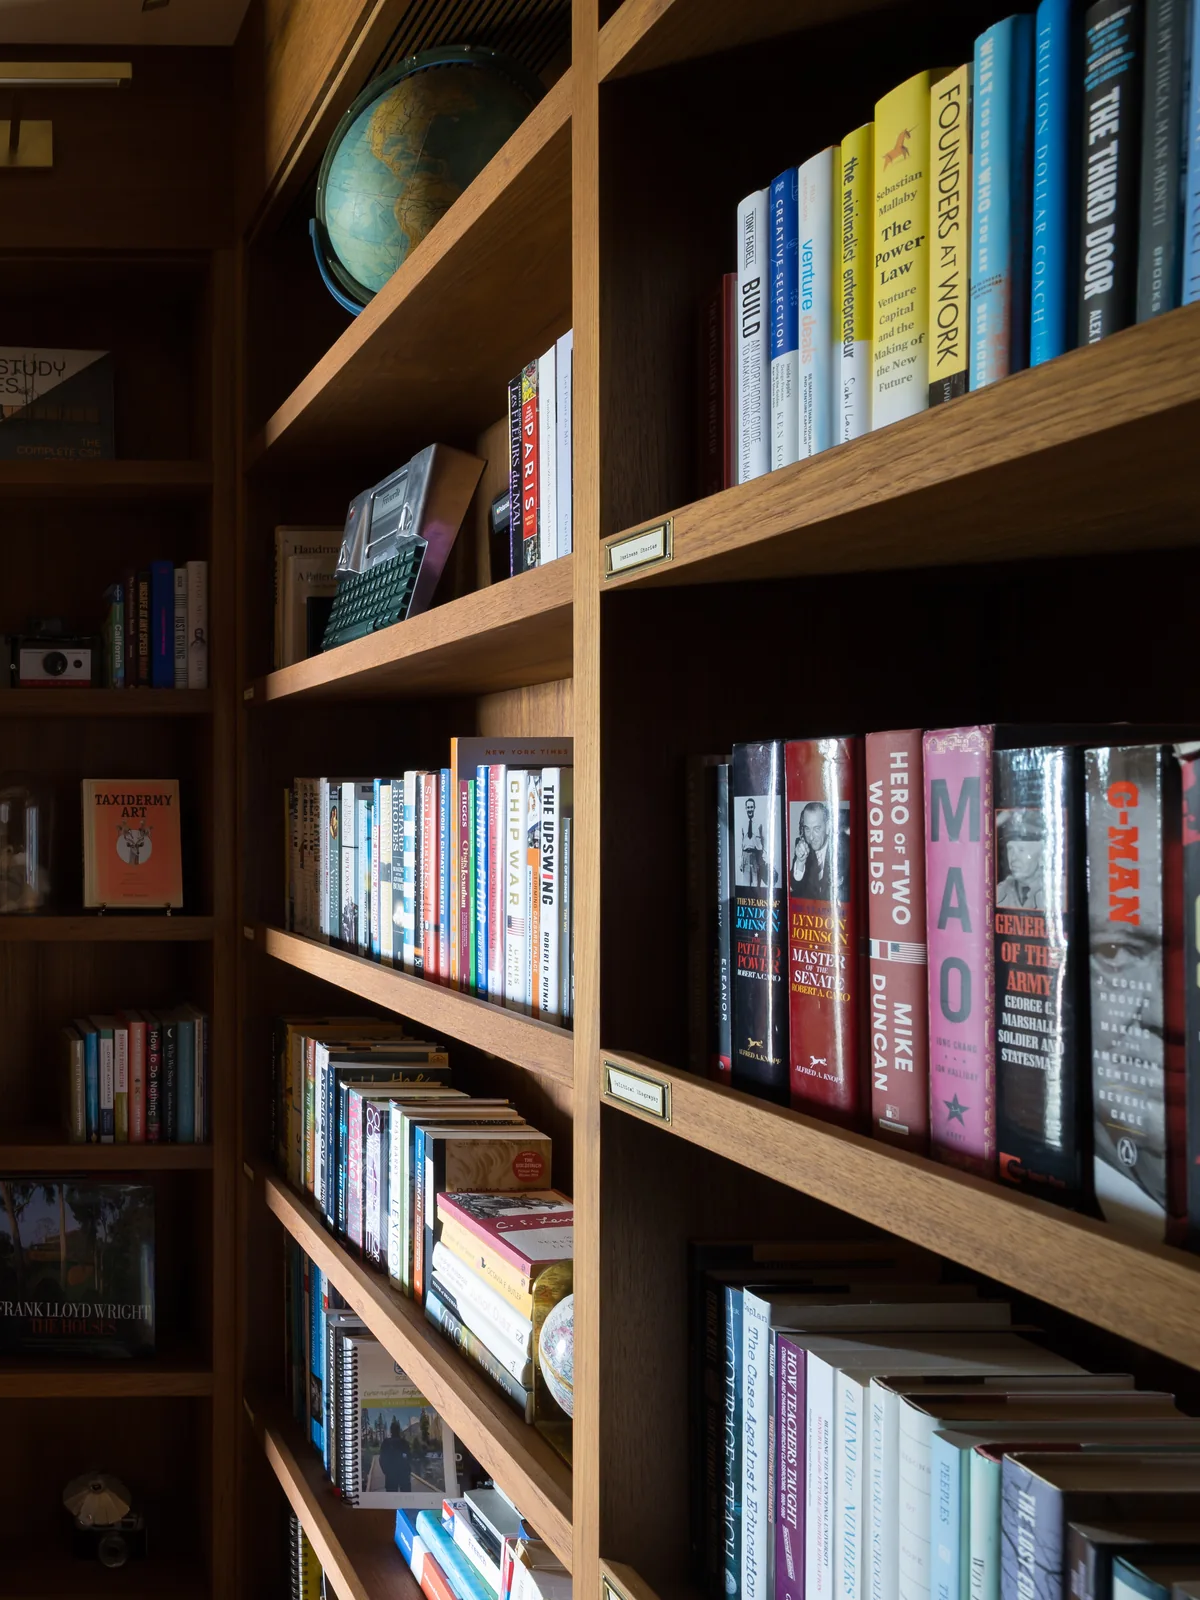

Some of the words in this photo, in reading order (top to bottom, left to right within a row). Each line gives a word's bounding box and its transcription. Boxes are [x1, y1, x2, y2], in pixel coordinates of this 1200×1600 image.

[1036, 22, 1052, 135] TRILLION
[1088, 86, 1121, 145] THE
[842, 156, 858, 184] the
[937, 81, 961, 242] FOUNDERS
[876, 169, 923, 203] Sebastian
[1034, 143, 1049, 237] DOLLAR
[1086, 142, 1119, 225] THIRD
[878, 188, 918, 218] Mallaby
[744, 210, 755, 235] TONY
[775, 198, 784, 268] CREATIVE
[842, 189, 860, 263] minimalist
[881, 217, 913, 243] The
[744, 235, 756, 269] FADELL
[875, 232, 926, 269] Power
[939, 245, 957, 274] AT
[1083, 223, 1116, 301] DOOR
[801, 239, 816, 311] venture
[880, 258, 914, 286] Law
[1032, 245, 1047, 325] COACH
[1151, 246, 1164, 313] BROOKS
[742, 276, 761, 339] BUILD
[775, 272, 784, 349] SELECTION
[841, 268, 857, 360] entrepreneur
[877, 284, 917, 310] Venture
[878, 302, 915, 326] Capital
[878, 327, 896, 343] and
[896, 319, 915, 337] the
[935, 275, 961, 368] WORK
[1088, 309, 1102, 336] ALEX
[801, 315, 817, 364] deals
[874, 340, 908, 363] Making
[909, 332, 925, 348] of
[876, 361, 891, 377] the
[892, 354, 918, 371] New
[878, 371, 913, 393] Future
[524, 422, 535, 512] PARIS
[139, 581, 148, 610] UNSAFE
[139, 610, 148, 618] AT
[139, 618, 148, 633] ANY
[175, 616, 185, 632] JUST
[114, 623, 123, 669] California
[139, 633, 148, 656] SPEED
[175, 634, 185, 660] GIVING
[94, 794, 173, 806] TAXIDERMY
[543, 785, 555, 816] THE
[888, 750, 910, 827] HERO
[121, 806, 147, 818] ART
[397, 788, 405, 853] RICHARD
[508, 780, 521, 841] CHIP
[868, 780, 885, 898] WORLDS
[893, 832, 907, 856] OF
[1107, 780, 1140, 927] G-MAN
[508, 849, 521, 907] WAR
[542, 820, 554, 906] UPSWING
[891, 859, 912, 927] TWO
[929, 775, 981, 1025] MAO
[735, 917, 781, 933] JOHNSON
[736, 905, 780, 921] LYNDON
[792, 912, 848, 931] LYNDON
[542, 931, 550, 965] ROBERT
[791, 926, 850, 946] JOHNSON
[542, 966, 549, 975] D.
[737, 956, 781, 974] POWER
[791, 947, 847, 970] MASTER
[1001, 940, 1021, 962] OF
[1023, 942, 1061, 969] THE
[541, 976, 550, 1012] PUTNAM
[720, 957, 729, 1022] ELEANOR
[791, 981, 817, 997] ROBERT
[817, 987, 826, 998] A.
[825, 988, 851, 1003] CARO
[793, 969, 846, 991] SENATE
[1006, 970, 1053, 997] ARMY
[1111, 976, 1154, 993] EDGAR
[1004, 994, 1043, 1014] GEORGE
[1100, 991, 1151, 1009] HOOVER
[149, 1031, 158, 1051] How
[871, 973, 888, 1093] DUNCAN
[893, 1001, 915, 1074] MIKE
[997, 1028, 1040, 1051] SOLDIER
[1040, 1036, 1065, 1057] AND
[1100, 1020, 1153, 1040] MAKING
[149, 1053, 158, 1063] to
[149, 1065, 158, 1079] Do
[1093, 1048, 1160, 1072] AMERICAN
[1096, 1067, 1157, 1090] CENTURY
[148, 1081, 158, 1117] Nothing
[319, 1072, 327, 1128] ATOMIC
[1110, 1107, 1144, 1127] GAGE
[318, 1130, 327, 1167] LOVE
[390, 1198, 400, 1278] LEXICON
[30, 1319, 58, 1334] THE
[61, 1319, 117, 1335] HOUSES
[46, 1300, 91, 1319] LLOYD
[94, 1302, 152, 1320] WRIGHT
[746, 1325, 760, 1362] The
[786, 1348, 798, 1389] HOW
[746, 1365, 760, 1413] Case
[786, 1391, 798, 1467] TEACHERS
[744, 1414, 760, 1494] Against
[786, 1467, 798, 1530] TAUGHT
[939, 1460, 951, 1526] PEEPLES
[1017, 1489, 1036, 1526] THE
[745, 1496, 760, 1598] Education
[1017, 1525, 1036, 1569] LOST
